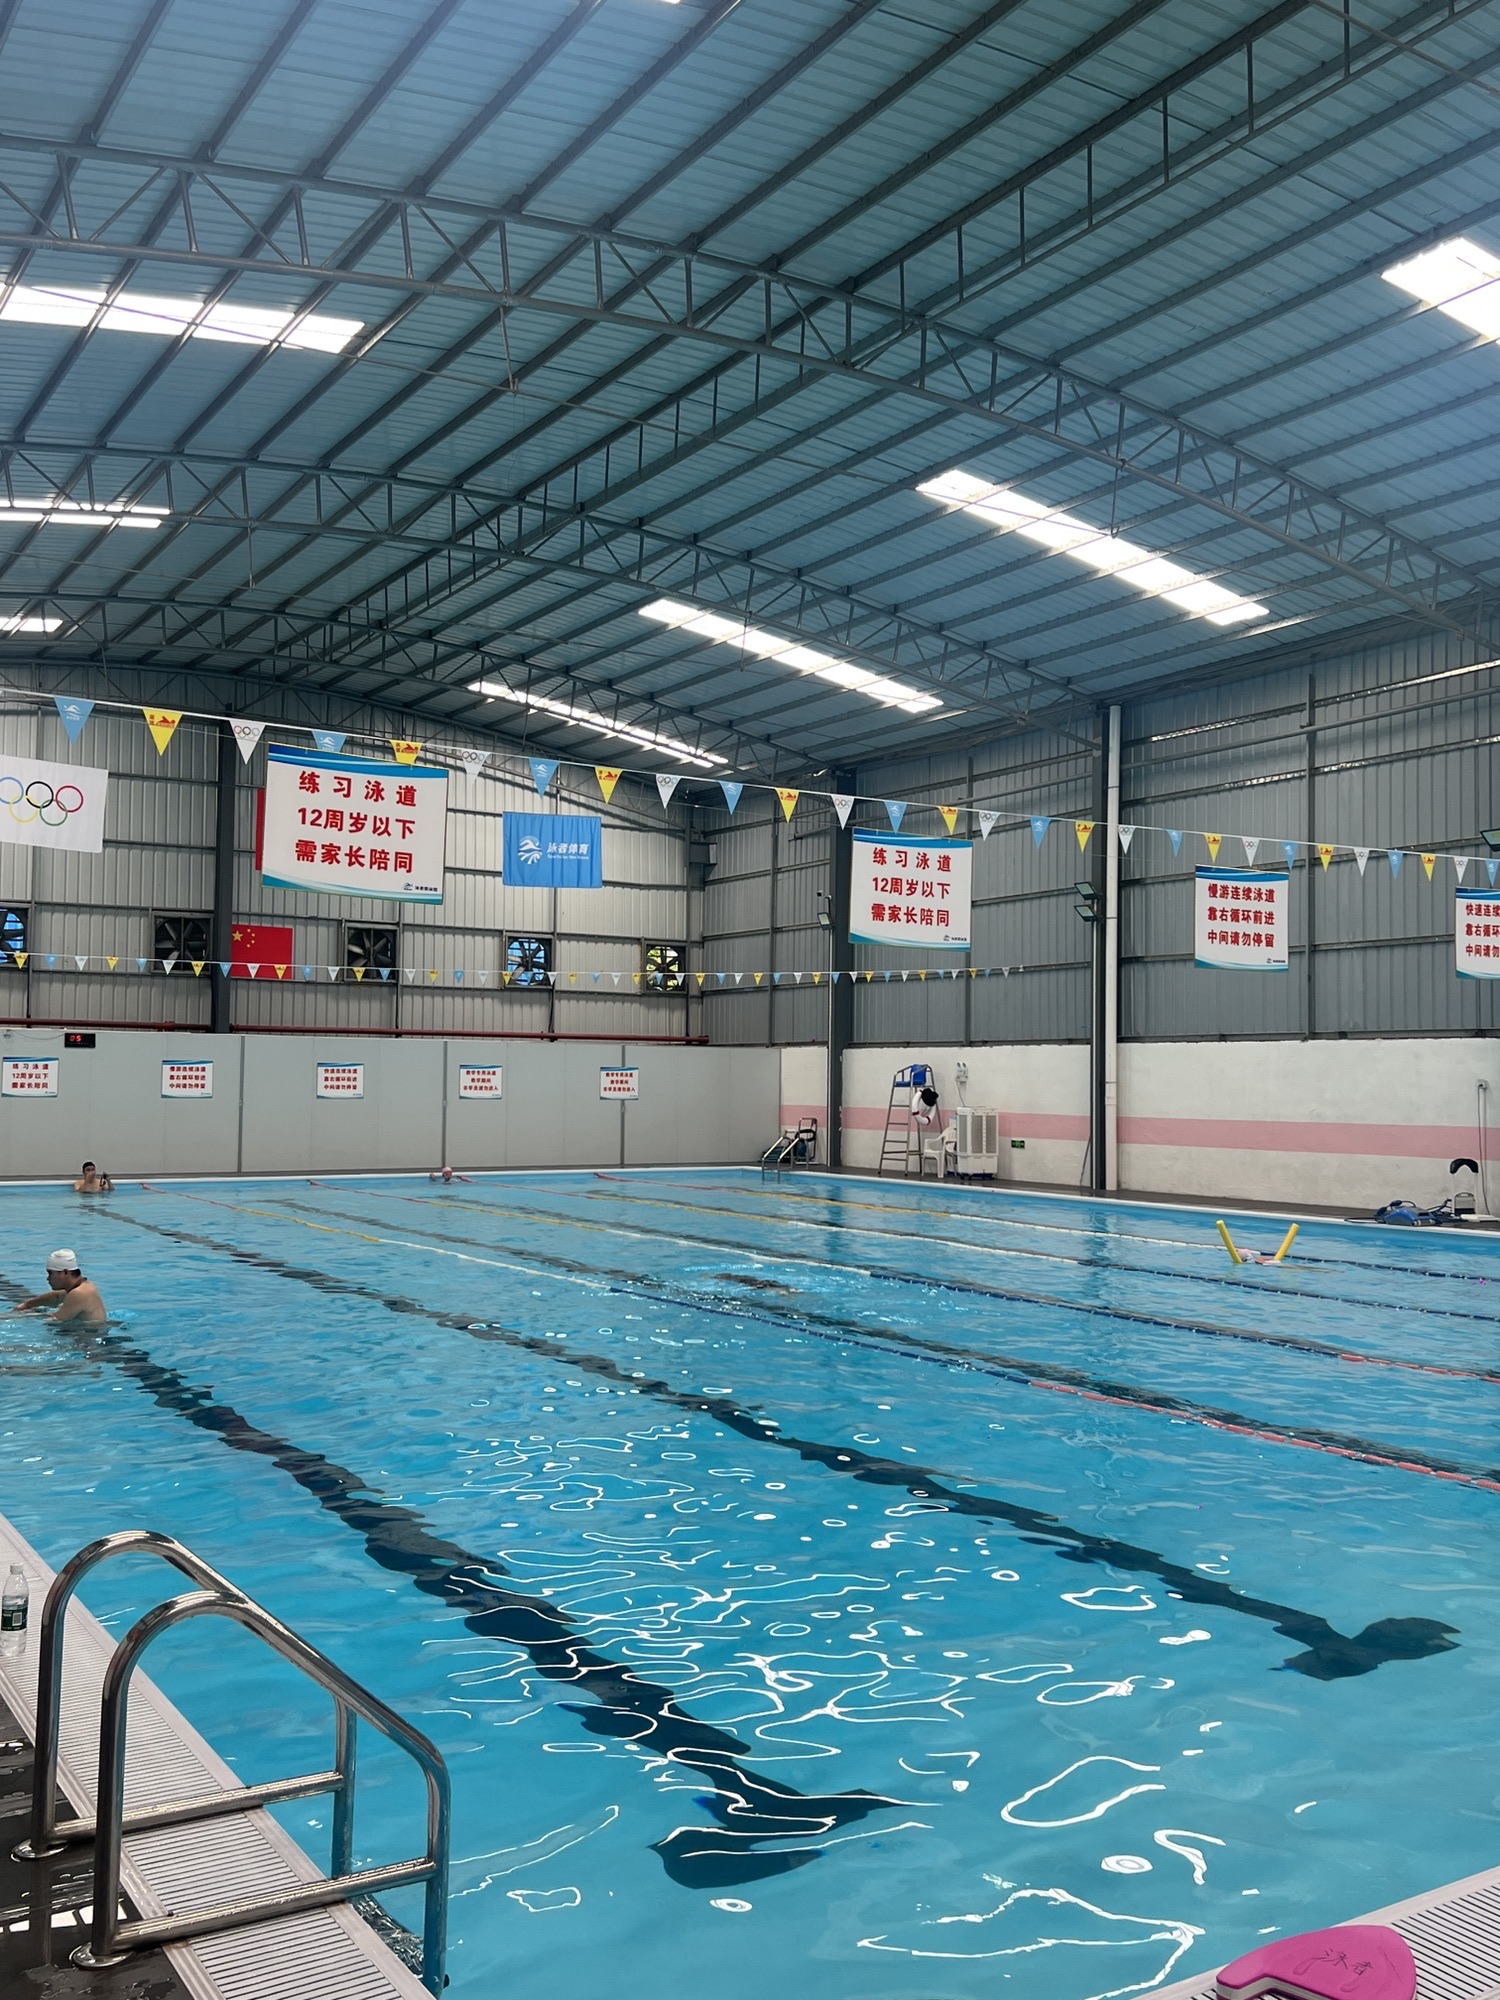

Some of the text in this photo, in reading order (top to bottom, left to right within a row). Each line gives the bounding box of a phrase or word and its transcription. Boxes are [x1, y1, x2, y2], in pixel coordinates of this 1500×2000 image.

[298, 770, 417, 807] 练习泳道
[297, 807, 416, 839] 12周岁以下
[295, 839, 414, 873] 需家长陪同
[872, 847, 952, 872] 练习泳道
[872, 877, 951, 899] 12周岁以下
[1207, 883, 1275, 903] 慢游连续泳道
[871, 903, 950, 927] 需家长陪同
[1207, 906, 1275, 925] 靠右循环前进
[1207, 929, 1275, 948] 中间请勿停留
[1465, 943, 1500, 958] 中间请勿
